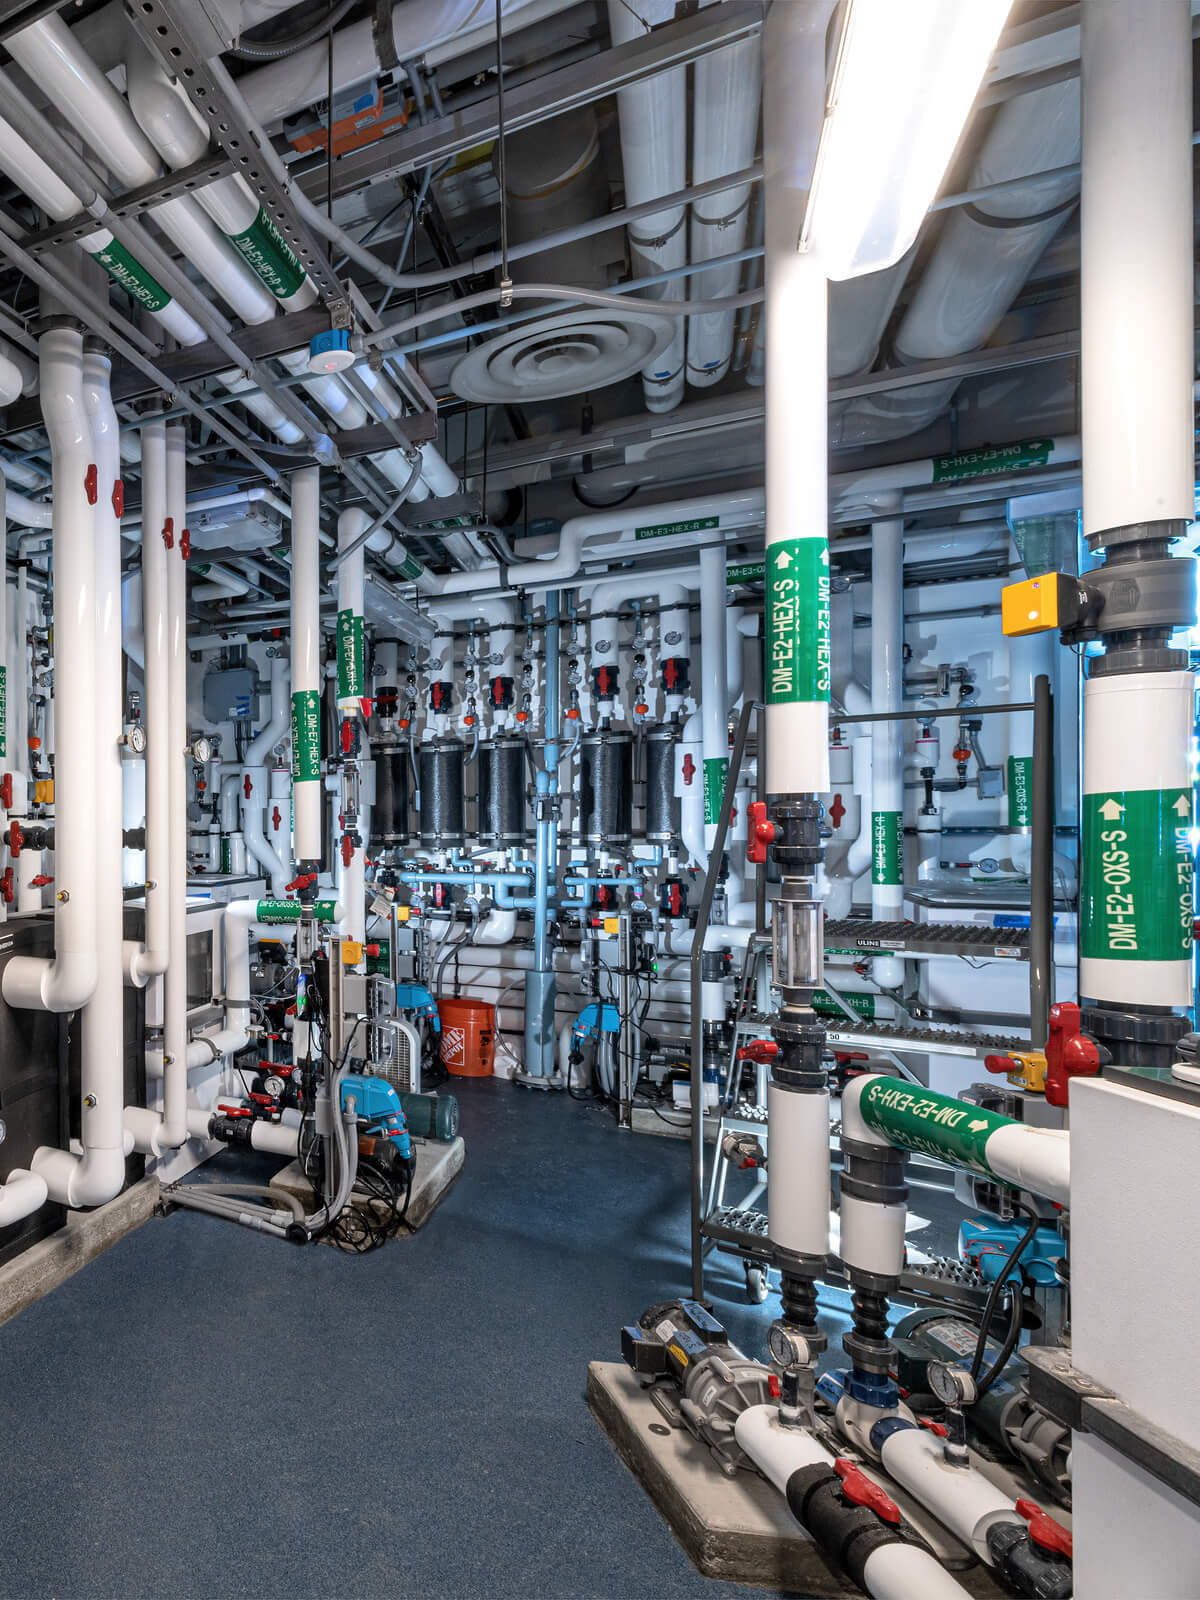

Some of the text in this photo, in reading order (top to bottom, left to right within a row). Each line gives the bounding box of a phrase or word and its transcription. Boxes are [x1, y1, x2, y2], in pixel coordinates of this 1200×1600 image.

[773, 579, 794, 694] DM-E2-HEX-S
[817, 576, 830, 691] DM-E2-HEX-S
[307, 713, 320, 775] DM-E7-HEX-S
[1014, 761, 1028, 811] DM-E3-OXS-R
[1101, 830, 1139, 950] DM-E2-OXS-S
[868, 1085, 969, 1127] DM-E2-EXH-S
